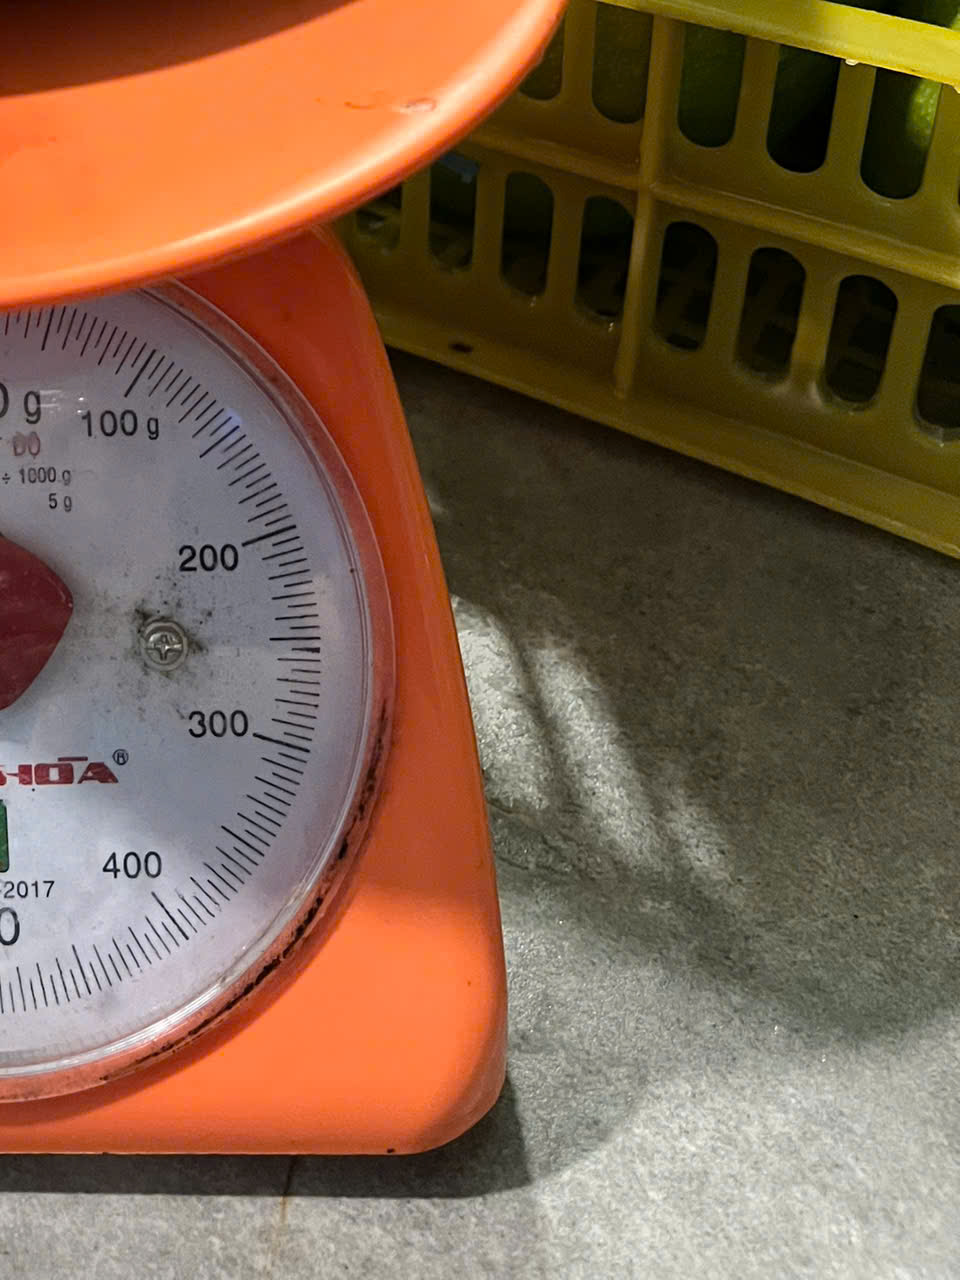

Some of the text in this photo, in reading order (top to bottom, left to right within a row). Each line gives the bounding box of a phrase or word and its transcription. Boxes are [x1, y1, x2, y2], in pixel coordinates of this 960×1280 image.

[24, 391, 41, 424] g
[81, 409, 159, 440] 100 g
[19, 466, 57, 484] 1000
[48, 493, 58, 510] 5
[178, 545, 239, 573] 200
[188, 710, 249, 738] 300
[102, 851, 163, 880] 400
